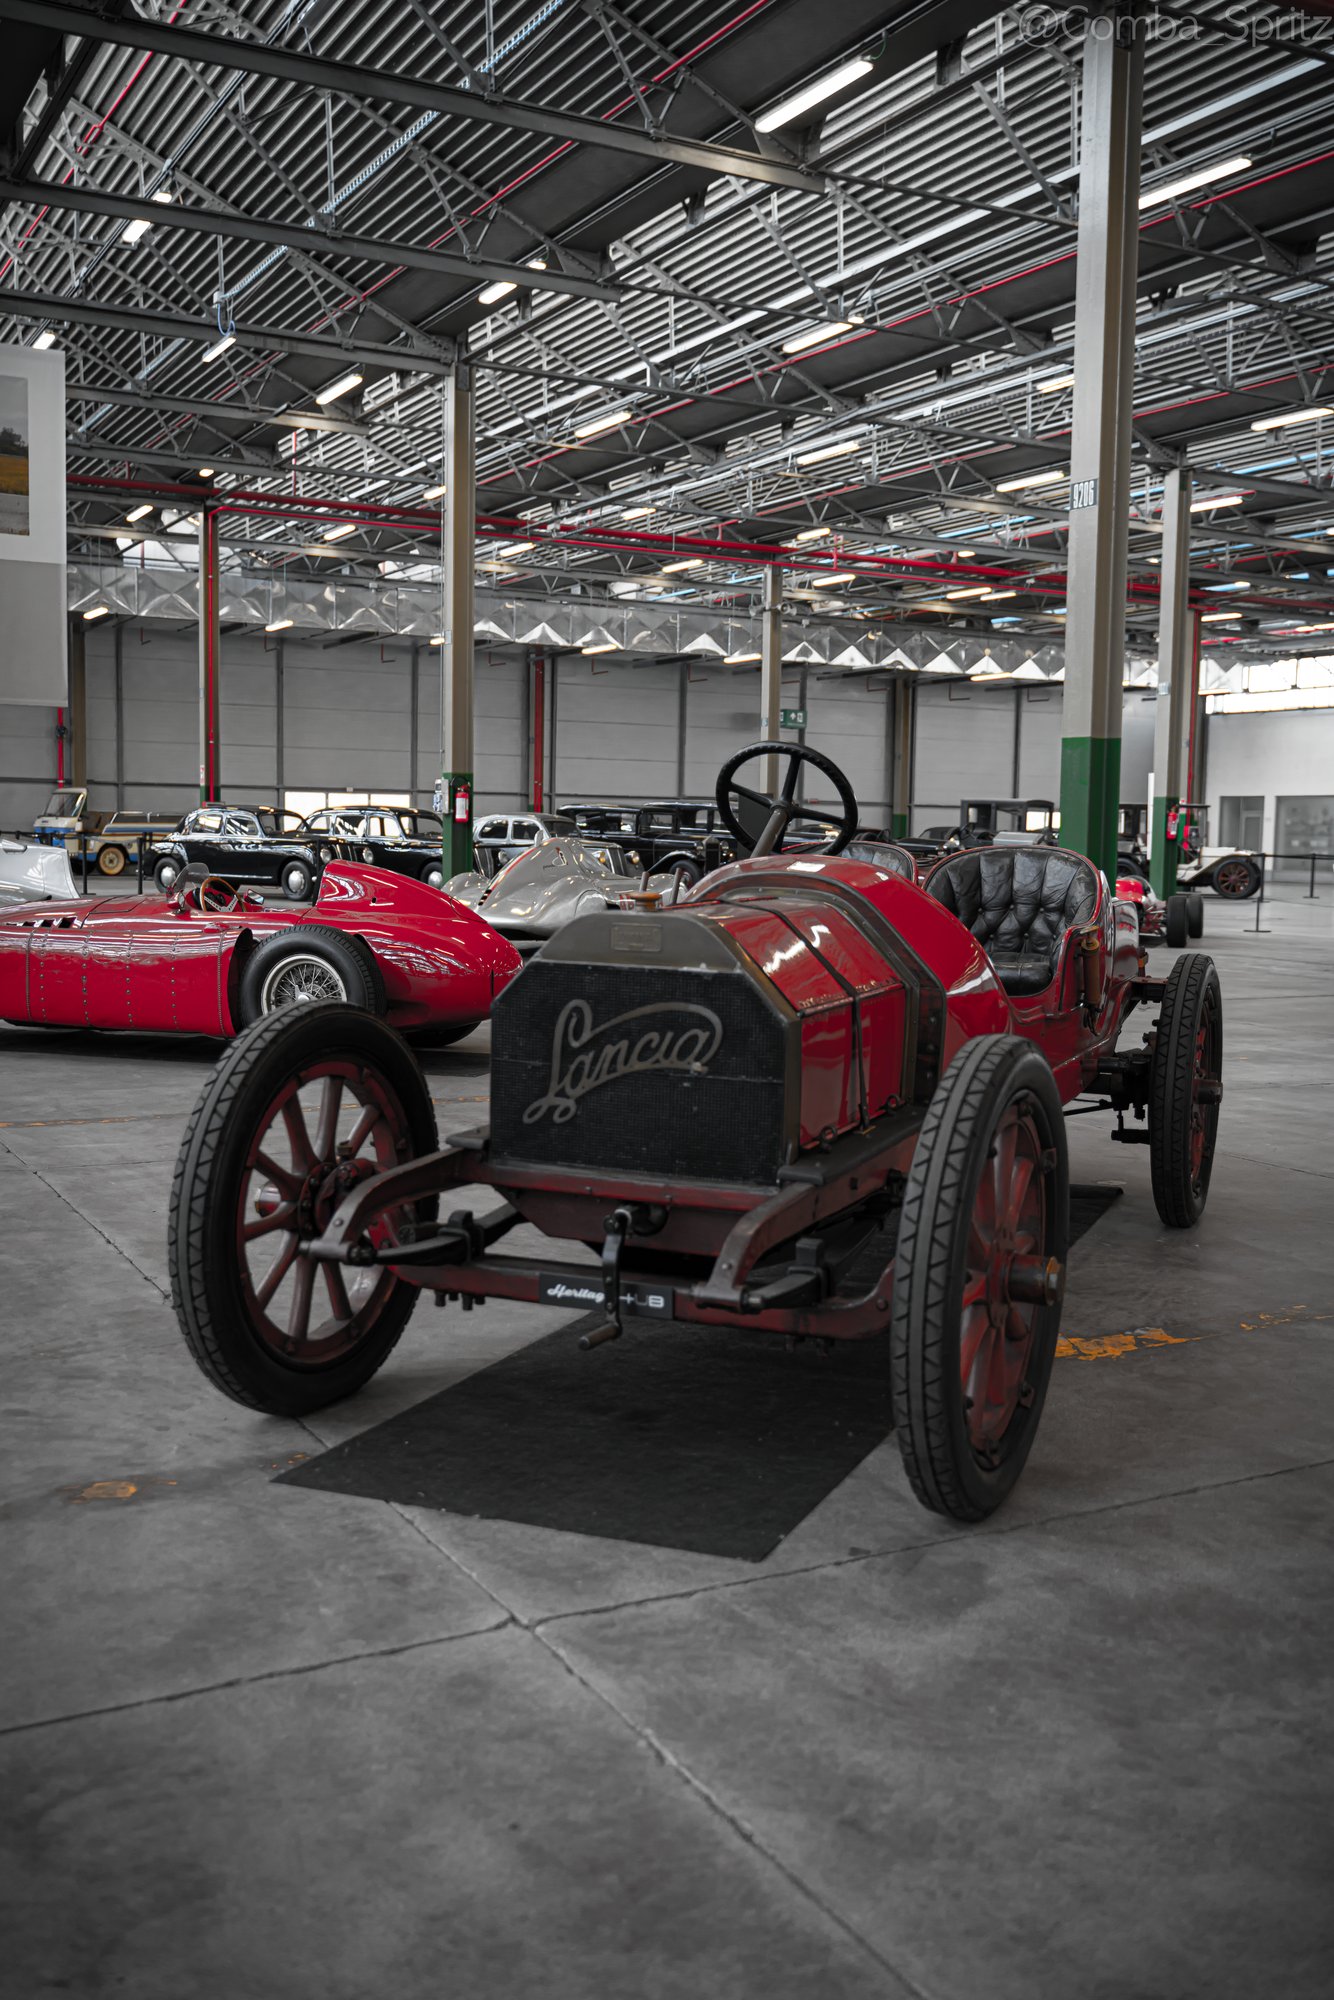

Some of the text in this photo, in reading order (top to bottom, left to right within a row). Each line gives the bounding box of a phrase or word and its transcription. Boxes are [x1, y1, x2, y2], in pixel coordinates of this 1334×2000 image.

[1073, 480, 1095, 509] 9206
[522, 999, 723, 1124] Lancia
[547, 1284, 605, 1303] Heritag
